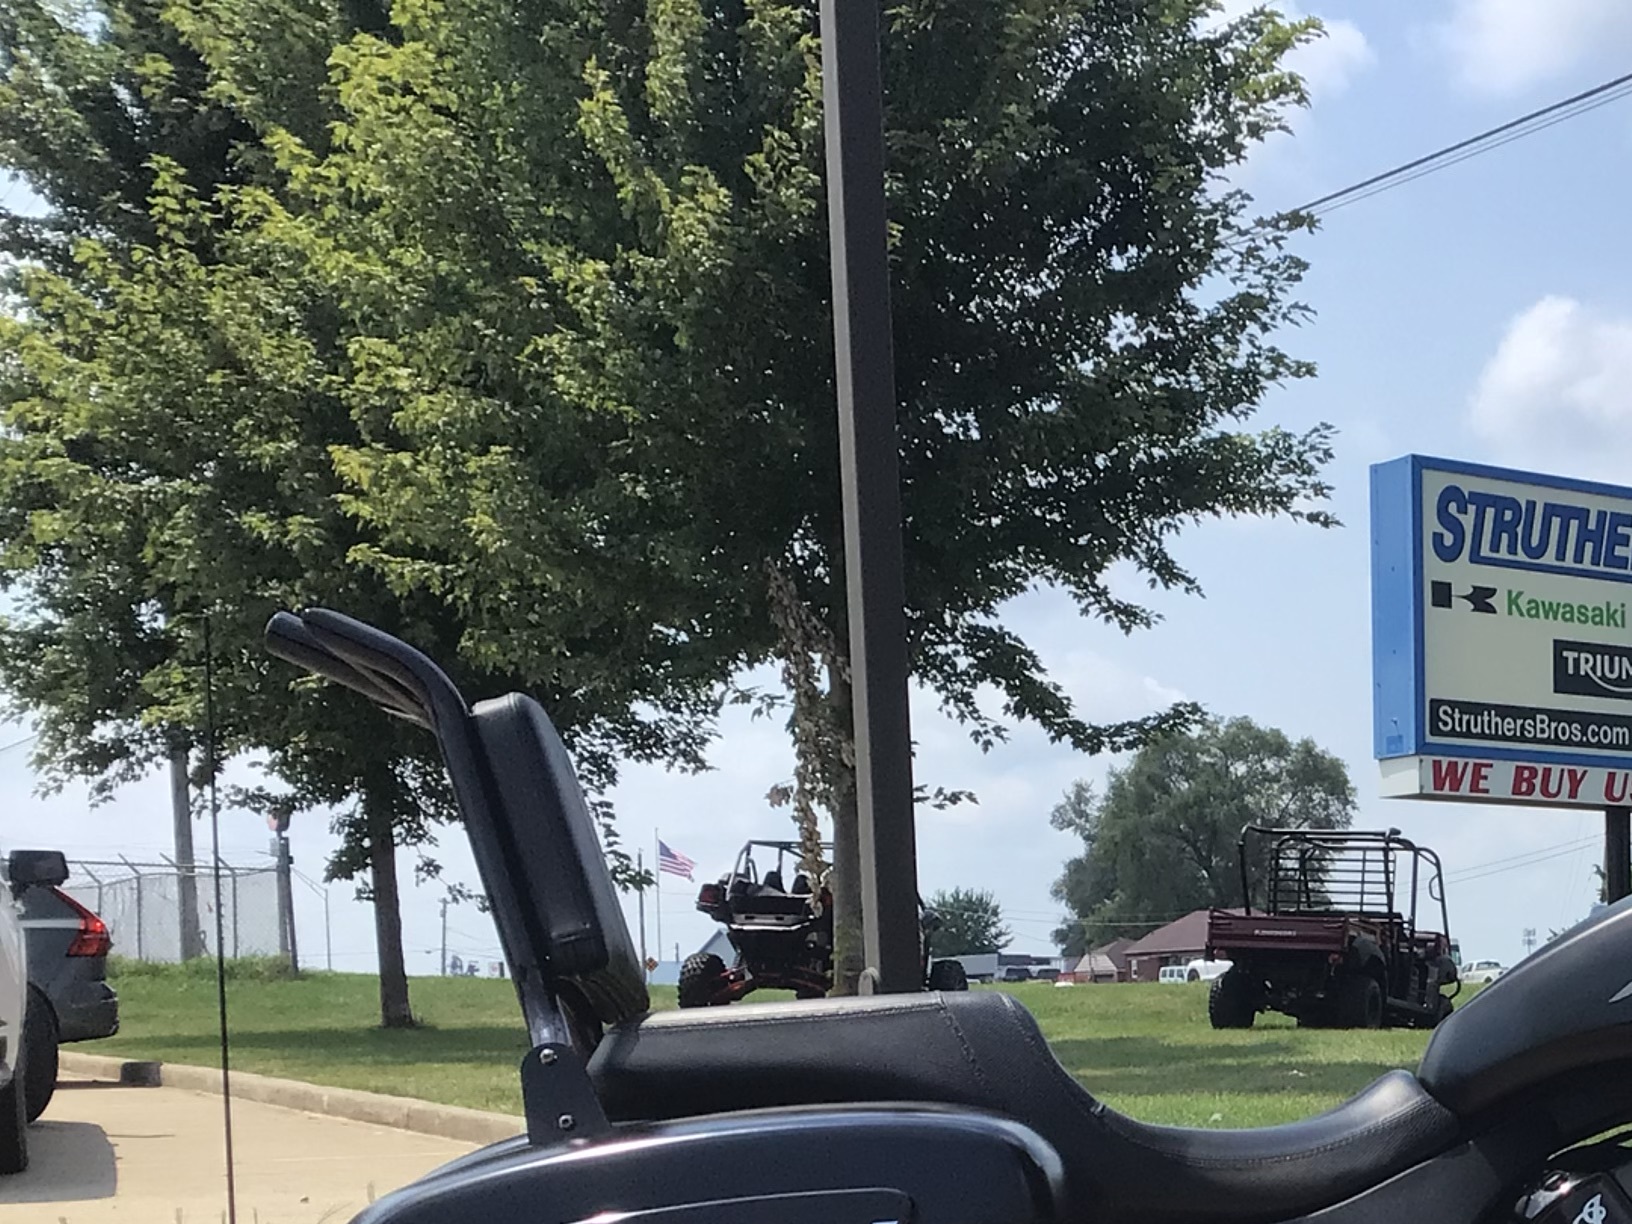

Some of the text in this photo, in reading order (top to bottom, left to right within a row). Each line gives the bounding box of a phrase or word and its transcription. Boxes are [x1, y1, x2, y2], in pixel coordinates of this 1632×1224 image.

[1507, 589, 1626, 628] Kawasaki
[1438, 705, 1630, 745] StruthersBros.com
[1432, 760, 1493, 793] WE
[1511, 765, 1587, 799] BUY
